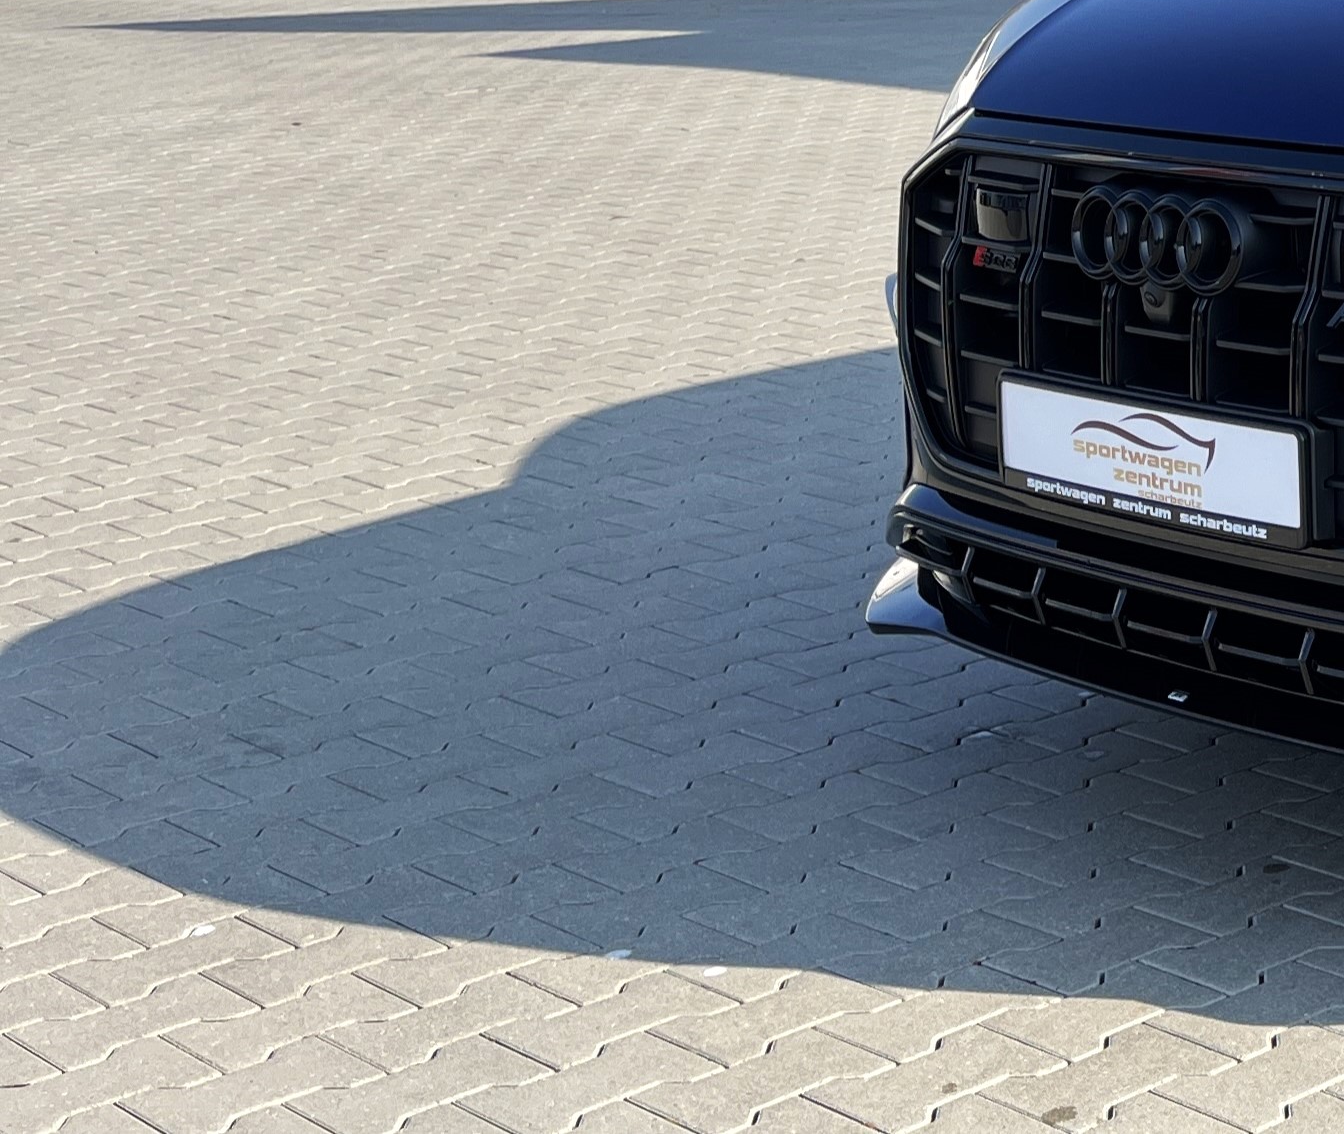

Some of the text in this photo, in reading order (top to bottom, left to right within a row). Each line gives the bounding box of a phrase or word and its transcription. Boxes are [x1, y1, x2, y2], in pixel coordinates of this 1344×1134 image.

[1073, 438, 1202, 478] sportwagen
[1113, 467, 1202, 498] zentrum
[1137, 488, 1203, 509] scharbeutz
[1026, 476, 1268, 539] sportwagen zentrum scharbeutz
